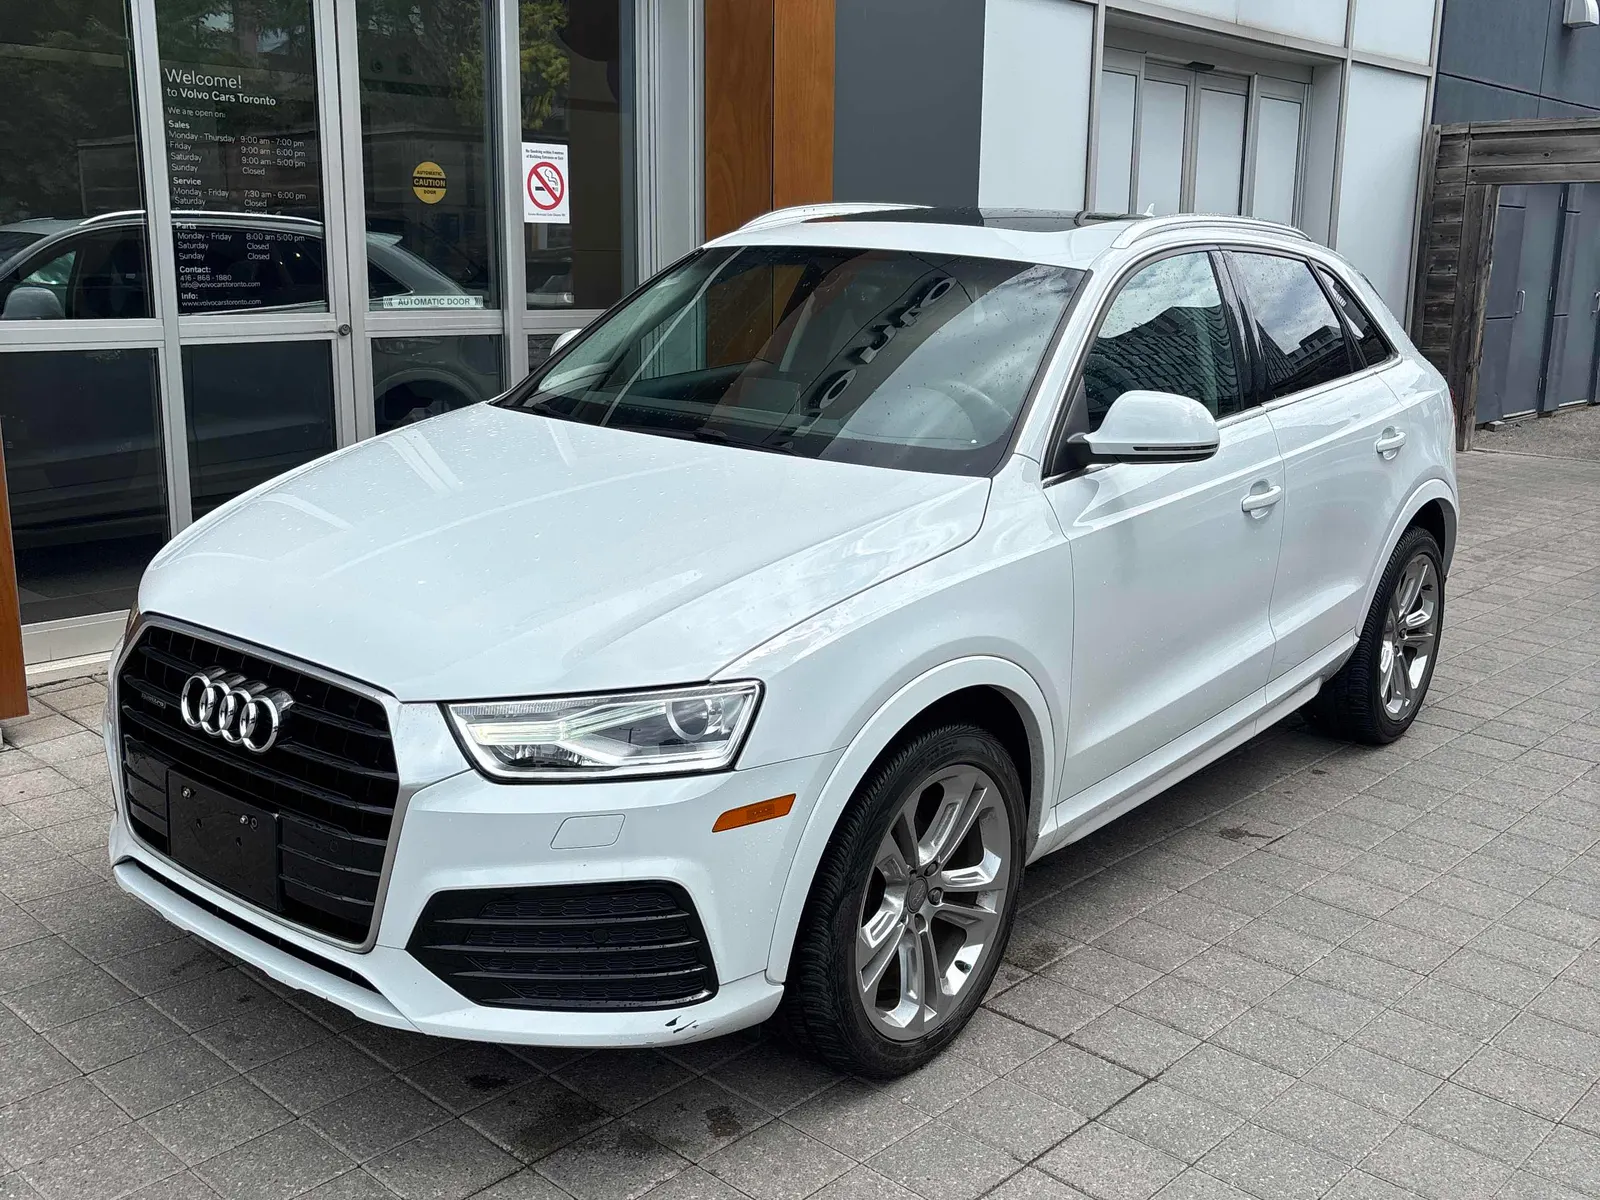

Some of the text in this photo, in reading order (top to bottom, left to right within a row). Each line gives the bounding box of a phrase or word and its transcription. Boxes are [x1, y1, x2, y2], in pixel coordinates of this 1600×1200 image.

[165, 68, 242, 89] Welcome!
[167, 87, 277, 106] to Volvo Cars Toronto
[168, 107, 181, 115] We
[195, 110, 213, 118] open
[168, 120, 190, 129] Sales
[169, 131, 198, 140] Monday
[204, 133, 235, 143] Thursday
[240, 135, 258, 144] 9:00
[276, 138, 292, 146] 7:00
[169, 141, 192, 151] Friday
[240, 146, 258, 154] 9:00
[276, 148, 293, 157] 6:00
[170, 152, 202, 162] Saturday
[241, 156, 259, 165] 9:00
[276, 159, 293, 167] 5:00
[294, 161, 306, 169] pm
[171, 163, 199, 173] Sunday
[242, 167, 266, 176] Closed
[173, 176, 202, 186] Service
[413, 178, 446, 187] CAUTION
[173, 186, 202, 196] Monday
[208, 188, 229, 198] Friday
[244, 189, 260, 198] 7:30
[277, 191, 294, 199] 6:00
[295, 193, 306, 201] pm
[174, 196, 206, 206] Saturday
[244, 200, 267, 208] Closed
[176, 222, 197, 231] Parts
[177, 232, 205, 241] Monday
[211, 233, 232, 242] Friday
[246, 232, 263, 241] 8:00
[277, 233, 293, 241] 5:00
[294, 235, 305, 243] pm
[178, 242, 209, 251] Saturday
[247, 242, 270, 250] Closed
[178, 252, 205, 261] Sunday
[247, 252, 270, 260] Closed
[179, 266, 211, 274] Contact:
[181, 299, 262, 307] www.volvocarstoronto.com
[398, 298, 470, 306] AUTOMATIC DOOR
